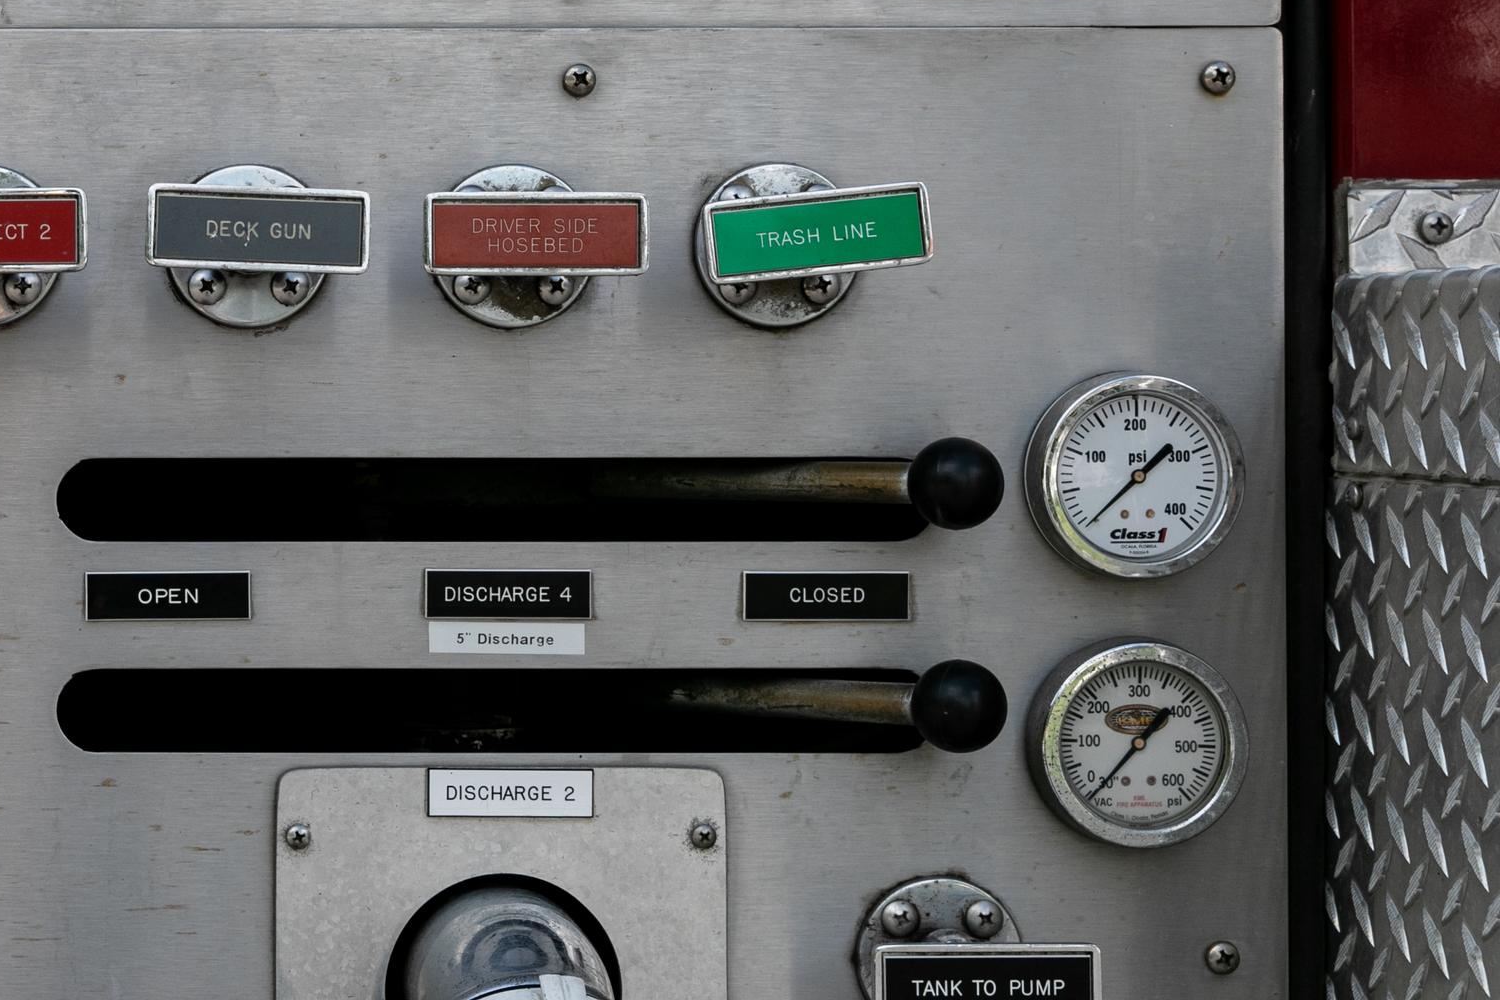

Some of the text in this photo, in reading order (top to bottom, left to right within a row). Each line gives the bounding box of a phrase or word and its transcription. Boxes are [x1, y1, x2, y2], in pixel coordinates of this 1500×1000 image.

[40, 223, 51, 239] 2
[206, 220, 312, 240] DECK GUN
[471, 217, 599, 234] DRIVER SIDE
[756, 221, 878, 249] TRASH LINE
[488, 237, 584, 254] HOSEBED
[1124, 419, 1146, 431] 200
[1085, 451, 1106, 463] 100
[1128, 450, 1146, 465] psi
[1168, 450, 1190, 463] 300
[1164, 503, 1186, 515] 400
[137, 587, 199, 605] OPEN
[444, 586, 572, 603] DISCHARGE 4
[789, 587, 864, 603] CLOSED
[477, 632, 555, 650] Discharge
[1128, 684, 1151, 697] 300
[1175, 740, 1197, 753] 500
[1162, 773, 1184, 786] 600
[445, 784, 575, 802] DISCHARGE 2
[911, 979, 1065, 996] TANK TO PUMP
